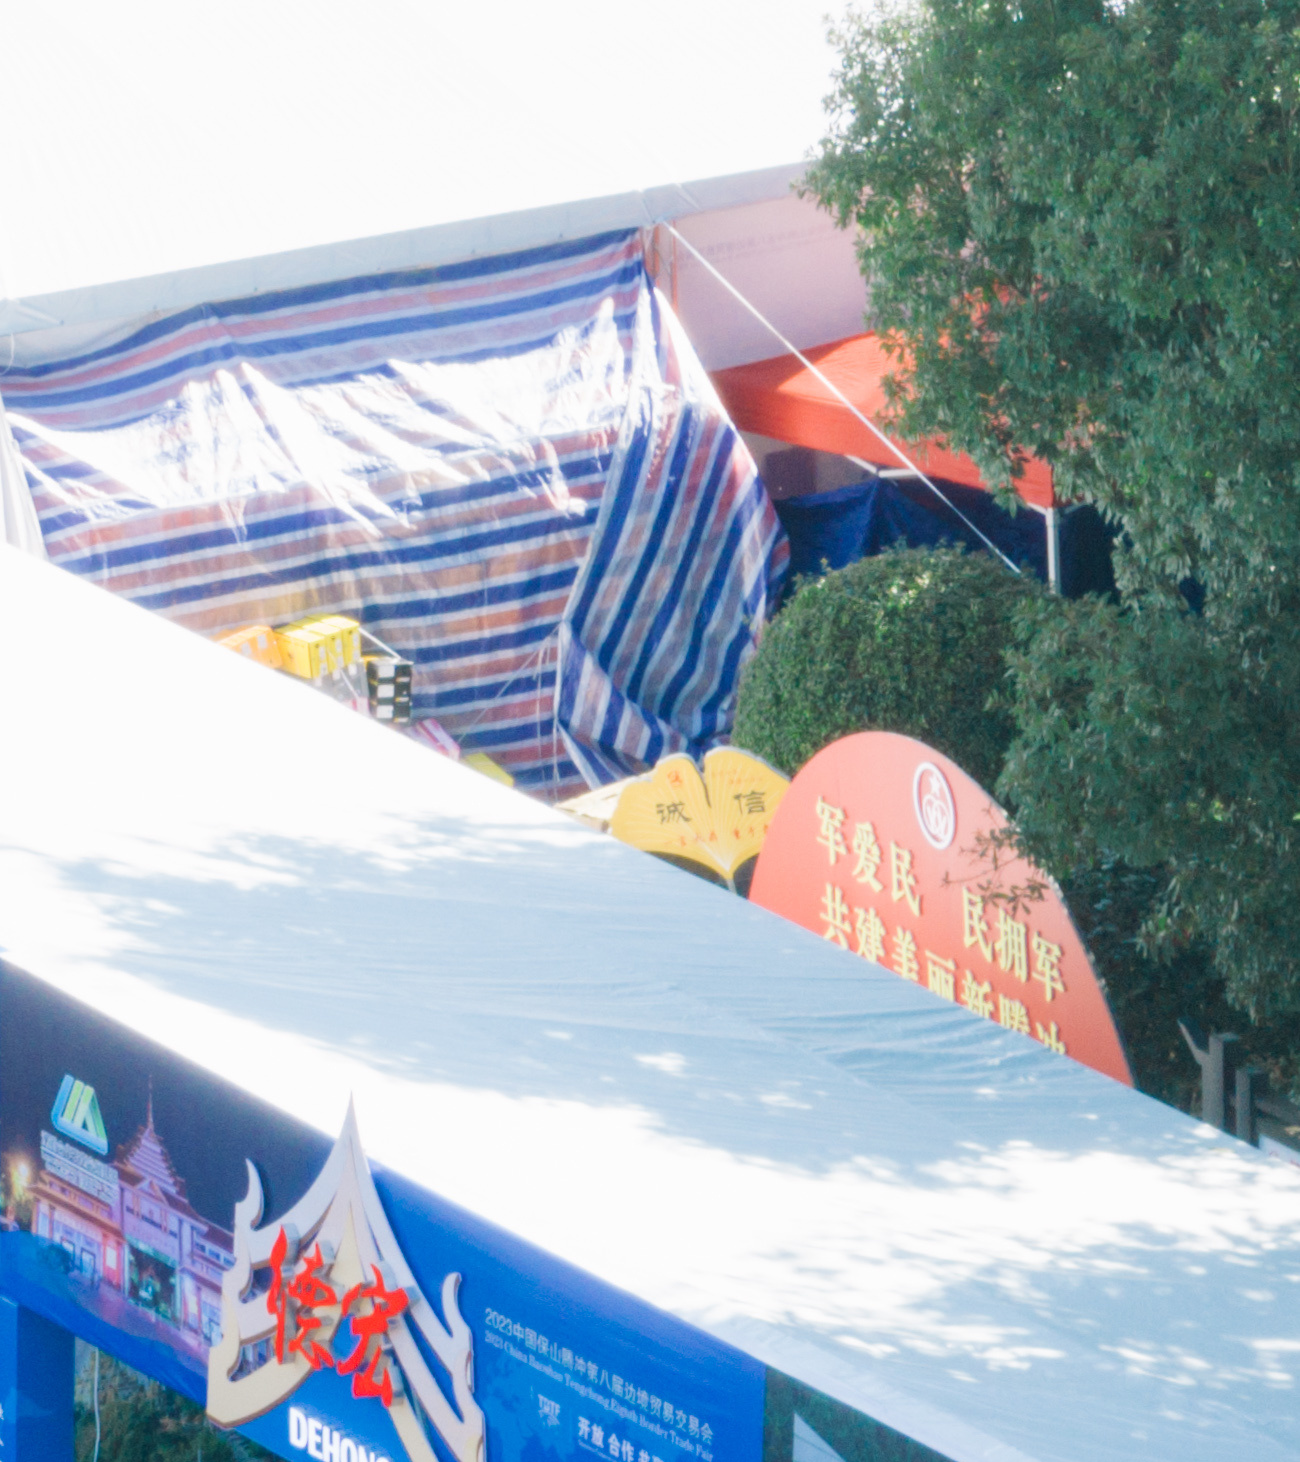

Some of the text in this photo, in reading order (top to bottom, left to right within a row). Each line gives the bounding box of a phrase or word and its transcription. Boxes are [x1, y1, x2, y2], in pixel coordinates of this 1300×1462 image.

[816, 796, 1066, 1003] 军爱民 民拥军
[267, 1224, 410, 1408] 德宏
[485, 1307, 713, 1446] 2023中国保山腾冲第八届边境贸易交易会
[578, 1416, 604, 1448] 开放
[607, 1432, 634, 1462] 合作
